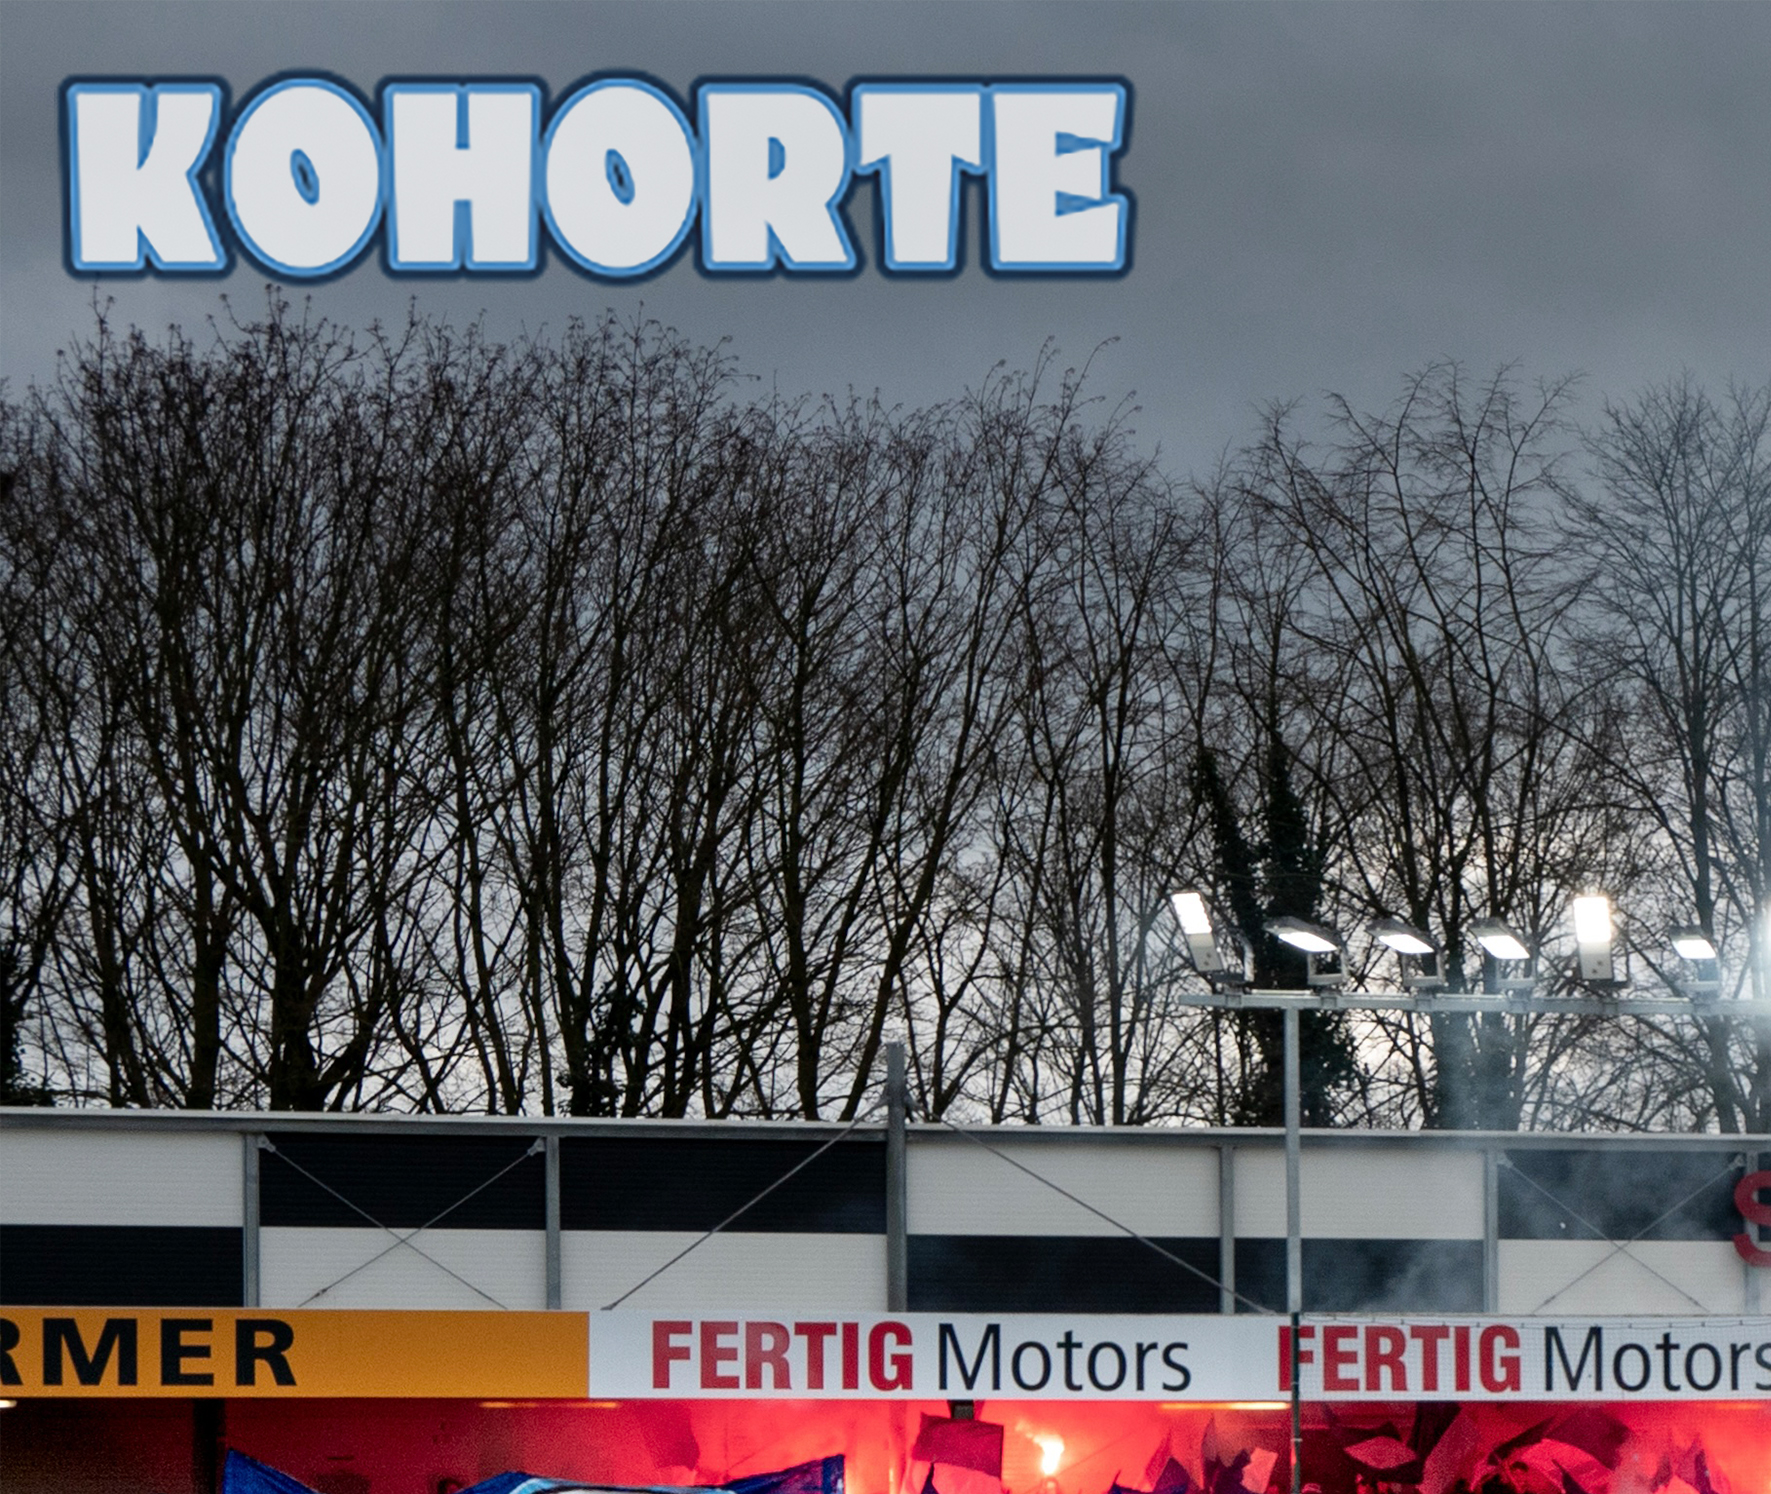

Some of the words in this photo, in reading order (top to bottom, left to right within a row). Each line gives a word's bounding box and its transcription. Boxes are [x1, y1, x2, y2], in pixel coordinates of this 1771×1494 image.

[652, 1320, 914, 1391] FERTIG
[938, 1323, 1192, 1392] Motors
[1278, 1325, 1521, 1392] FERTIG
